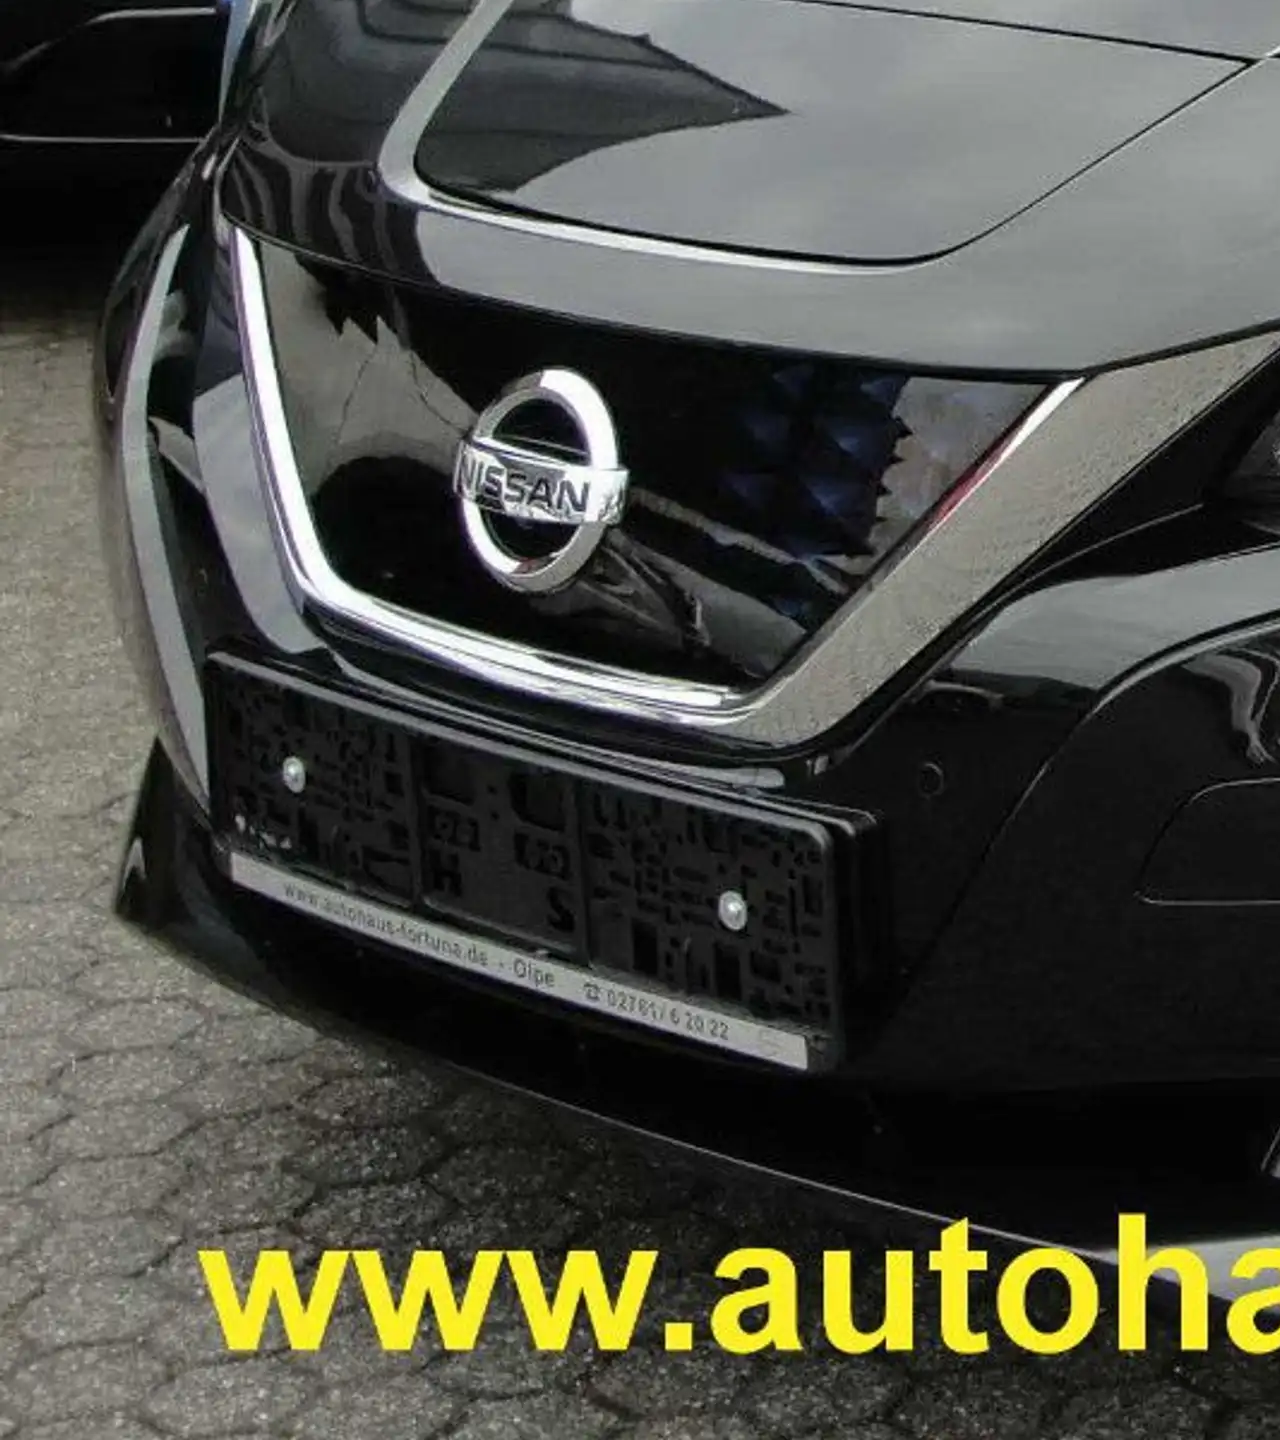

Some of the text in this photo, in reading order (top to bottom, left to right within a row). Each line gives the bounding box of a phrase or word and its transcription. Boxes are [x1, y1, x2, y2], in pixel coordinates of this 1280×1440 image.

[456, 453, 591, 513] NISSAN
[283, 881, 489, 968] www.autohaus-fortuna.de
[512, 958, 555, 989] Olpe
